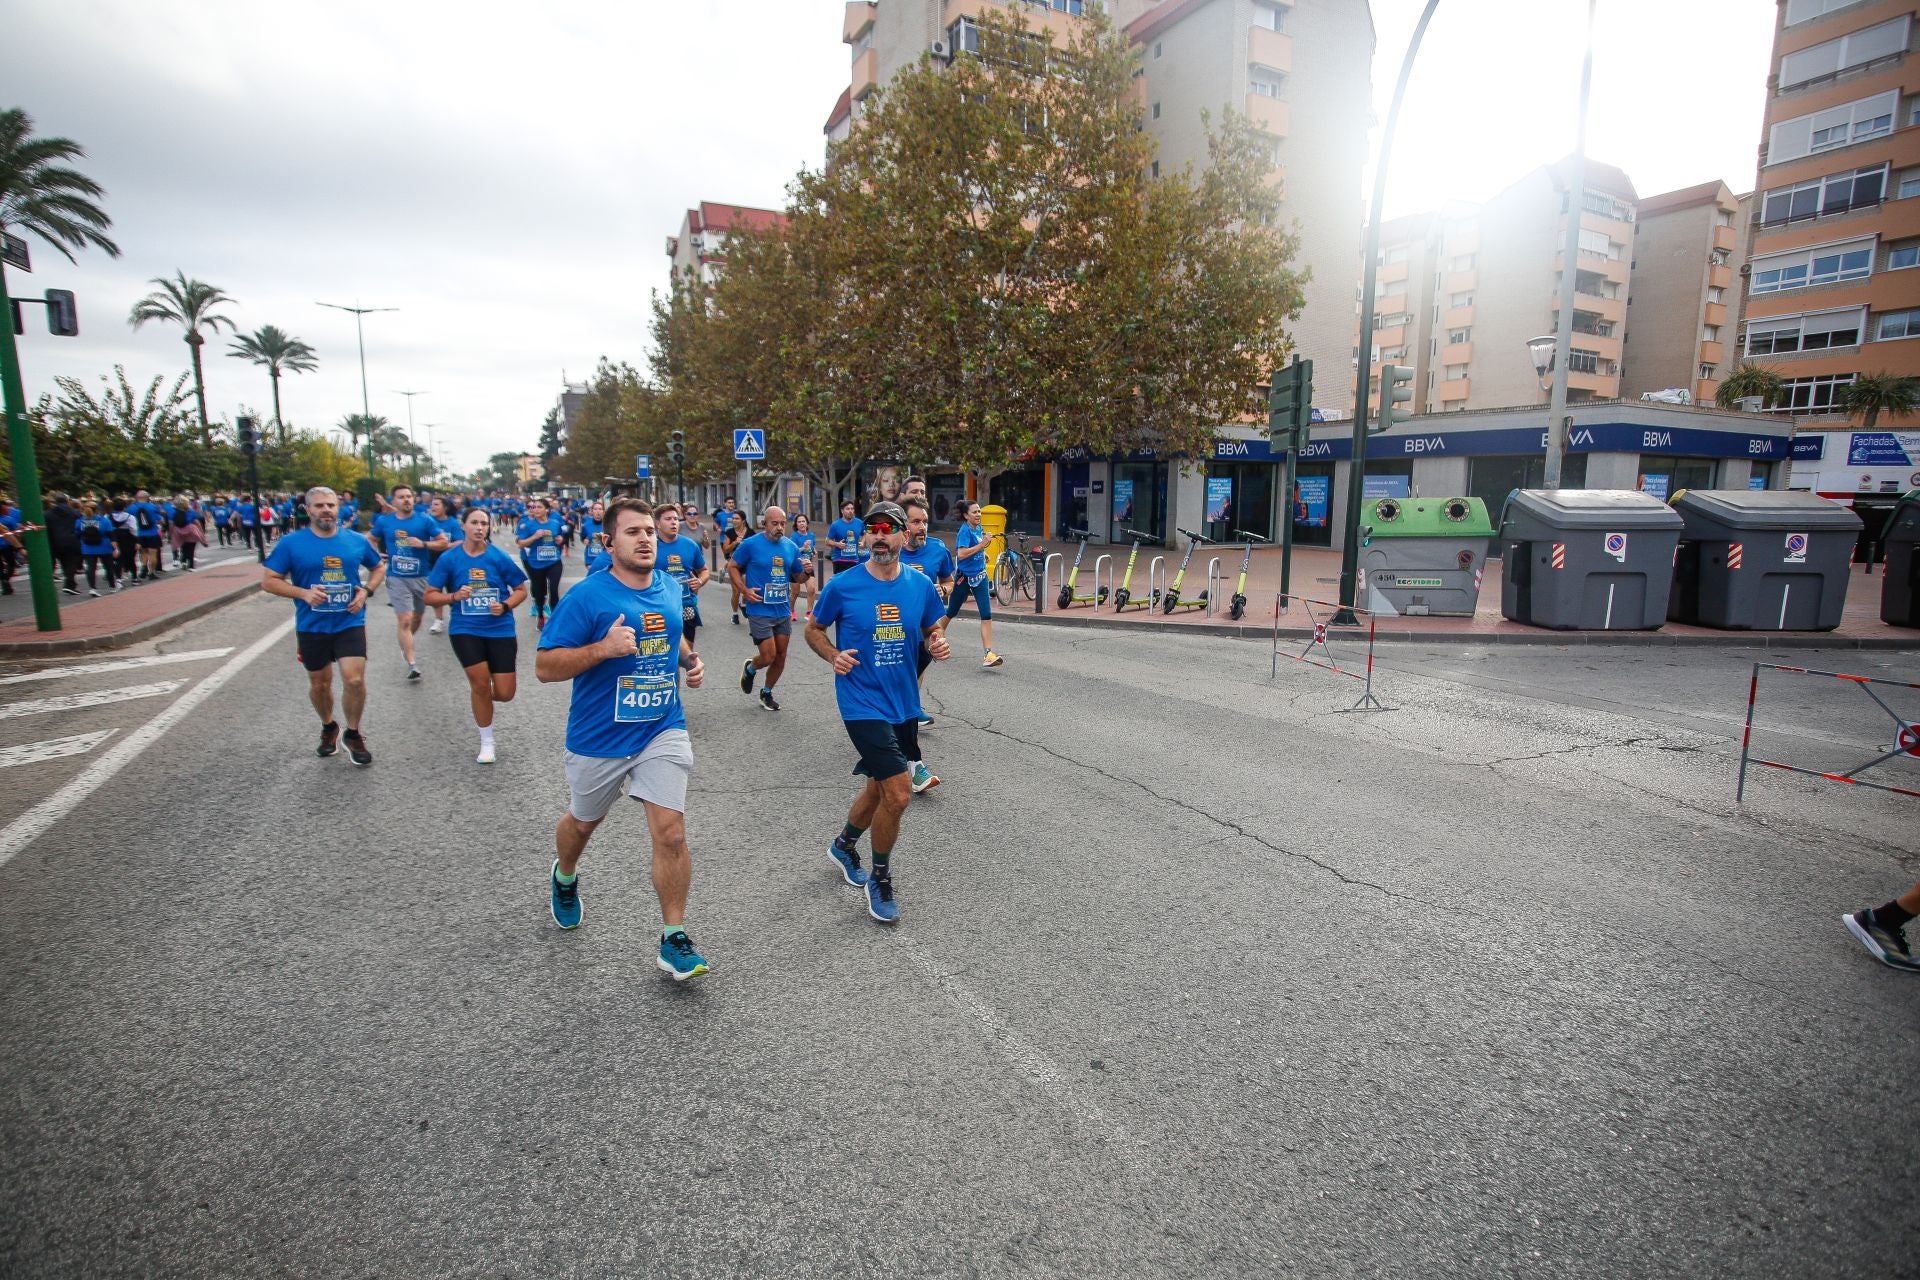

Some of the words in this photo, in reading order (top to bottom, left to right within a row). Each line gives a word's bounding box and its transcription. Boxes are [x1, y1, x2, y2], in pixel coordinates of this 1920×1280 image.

[1404, 436, 1446, 453] BBVA
[1541, 429, 1594, 448] BVA
[1643, 431, 1672, 447] BBVA
[1749, 439, 1772, 453] BBVA
[1853, 435, 1895, 446] Fachadas
[1218, 442, 1249, 456] BBVA
[622, 689, 673, 708] 4057
